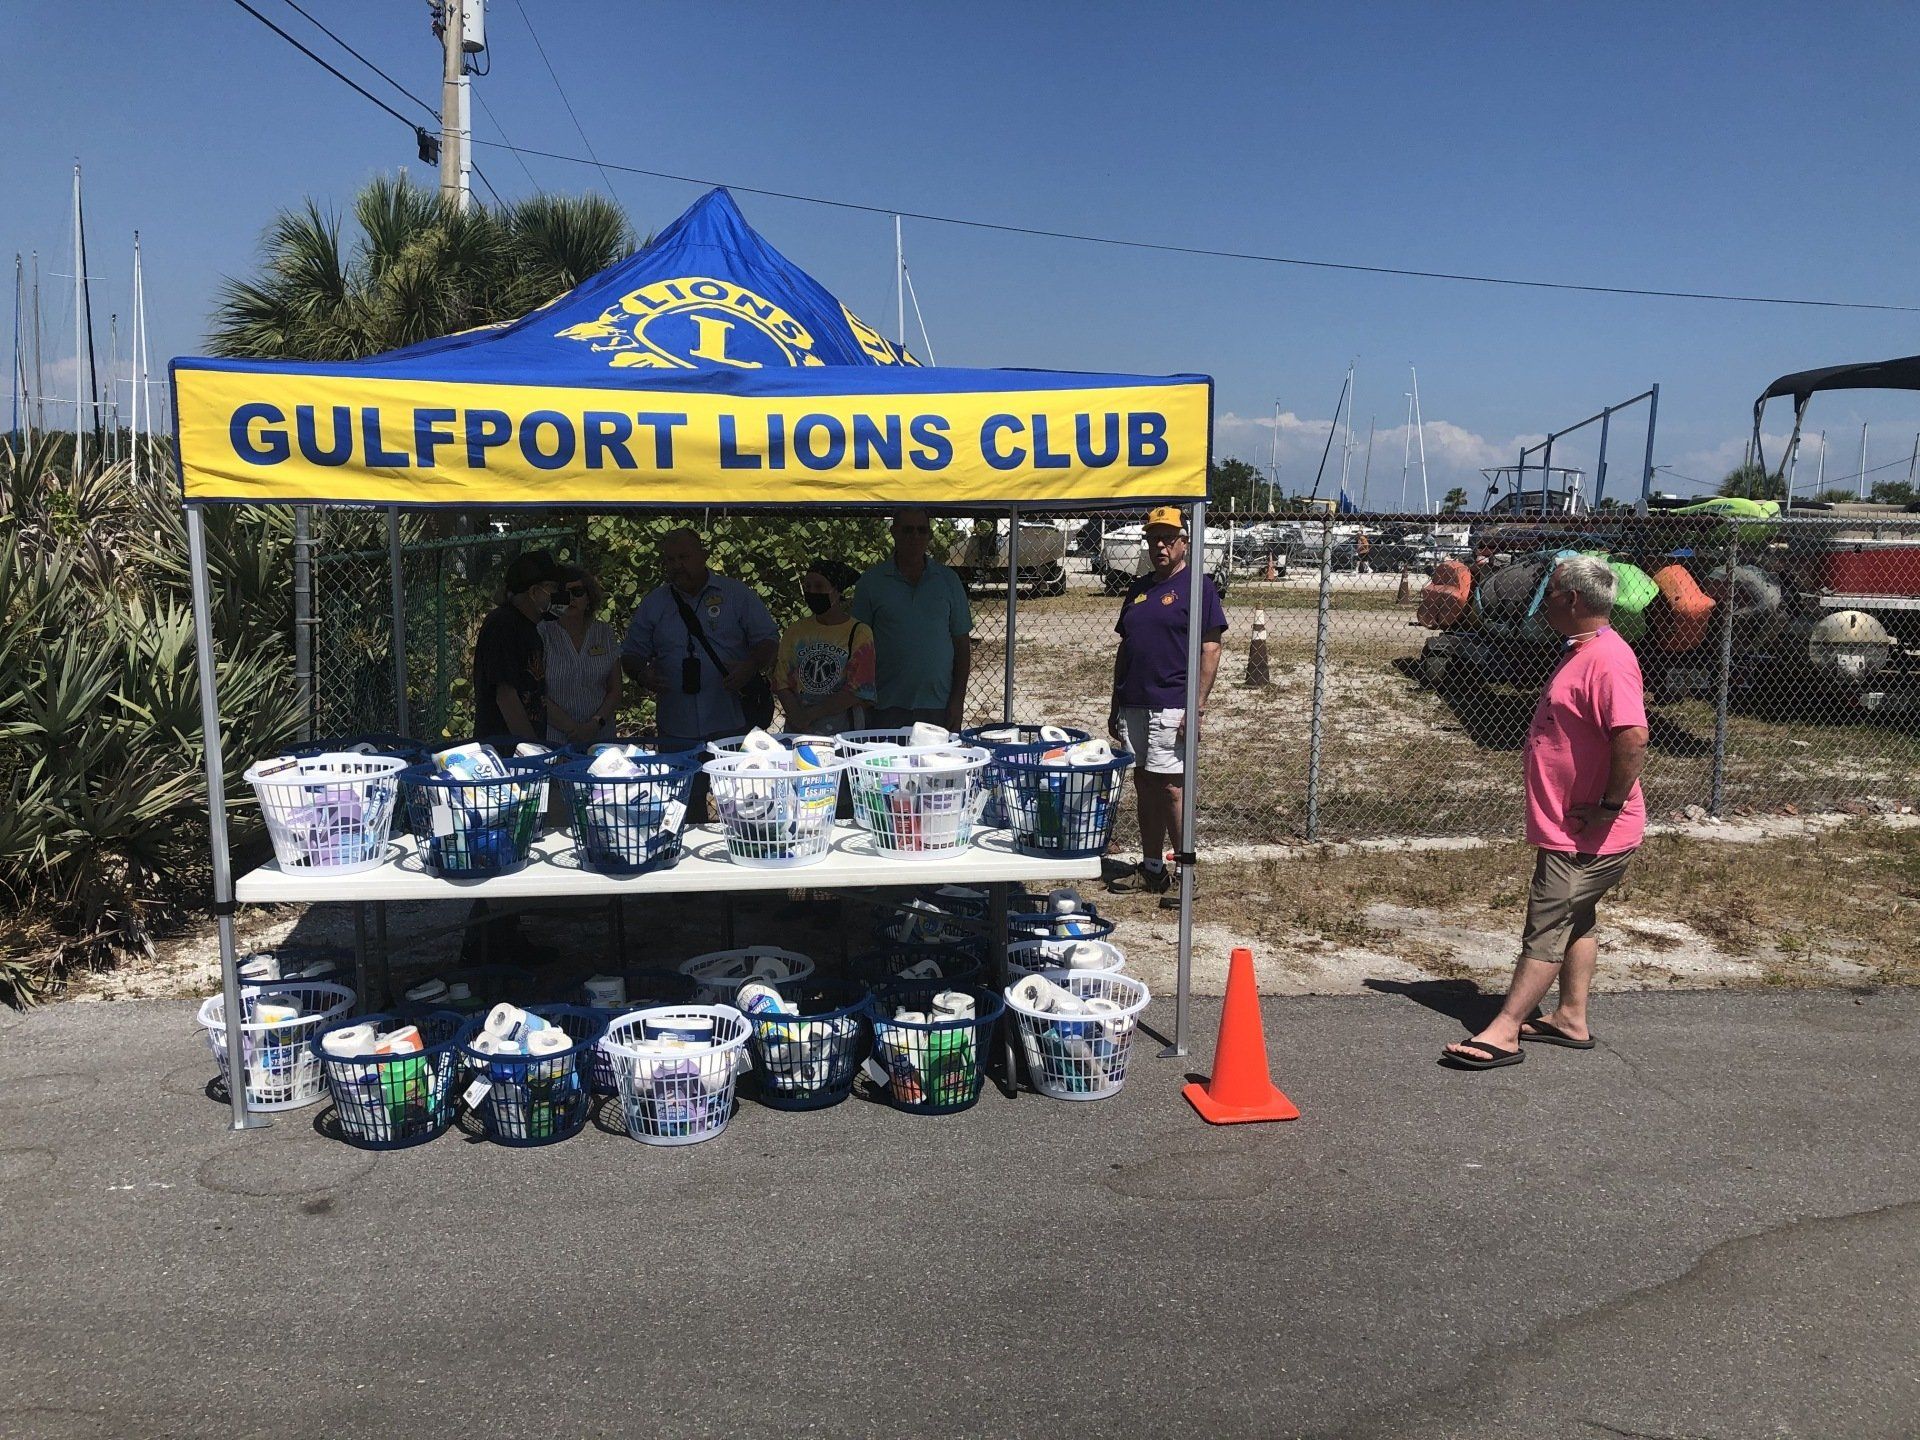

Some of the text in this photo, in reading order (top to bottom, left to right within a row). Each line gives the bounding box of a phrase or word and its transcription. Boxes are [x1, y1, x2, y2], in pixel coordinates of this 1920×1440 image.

[633, 282, 804, 341] LIONS
[690, 314, 763, 369] L
[229, 402, 1169, 471] GULFPORT LIONS CLUB
[798, 643, 848, 657] GULFPORT
[814, 660, 828, 683] K
